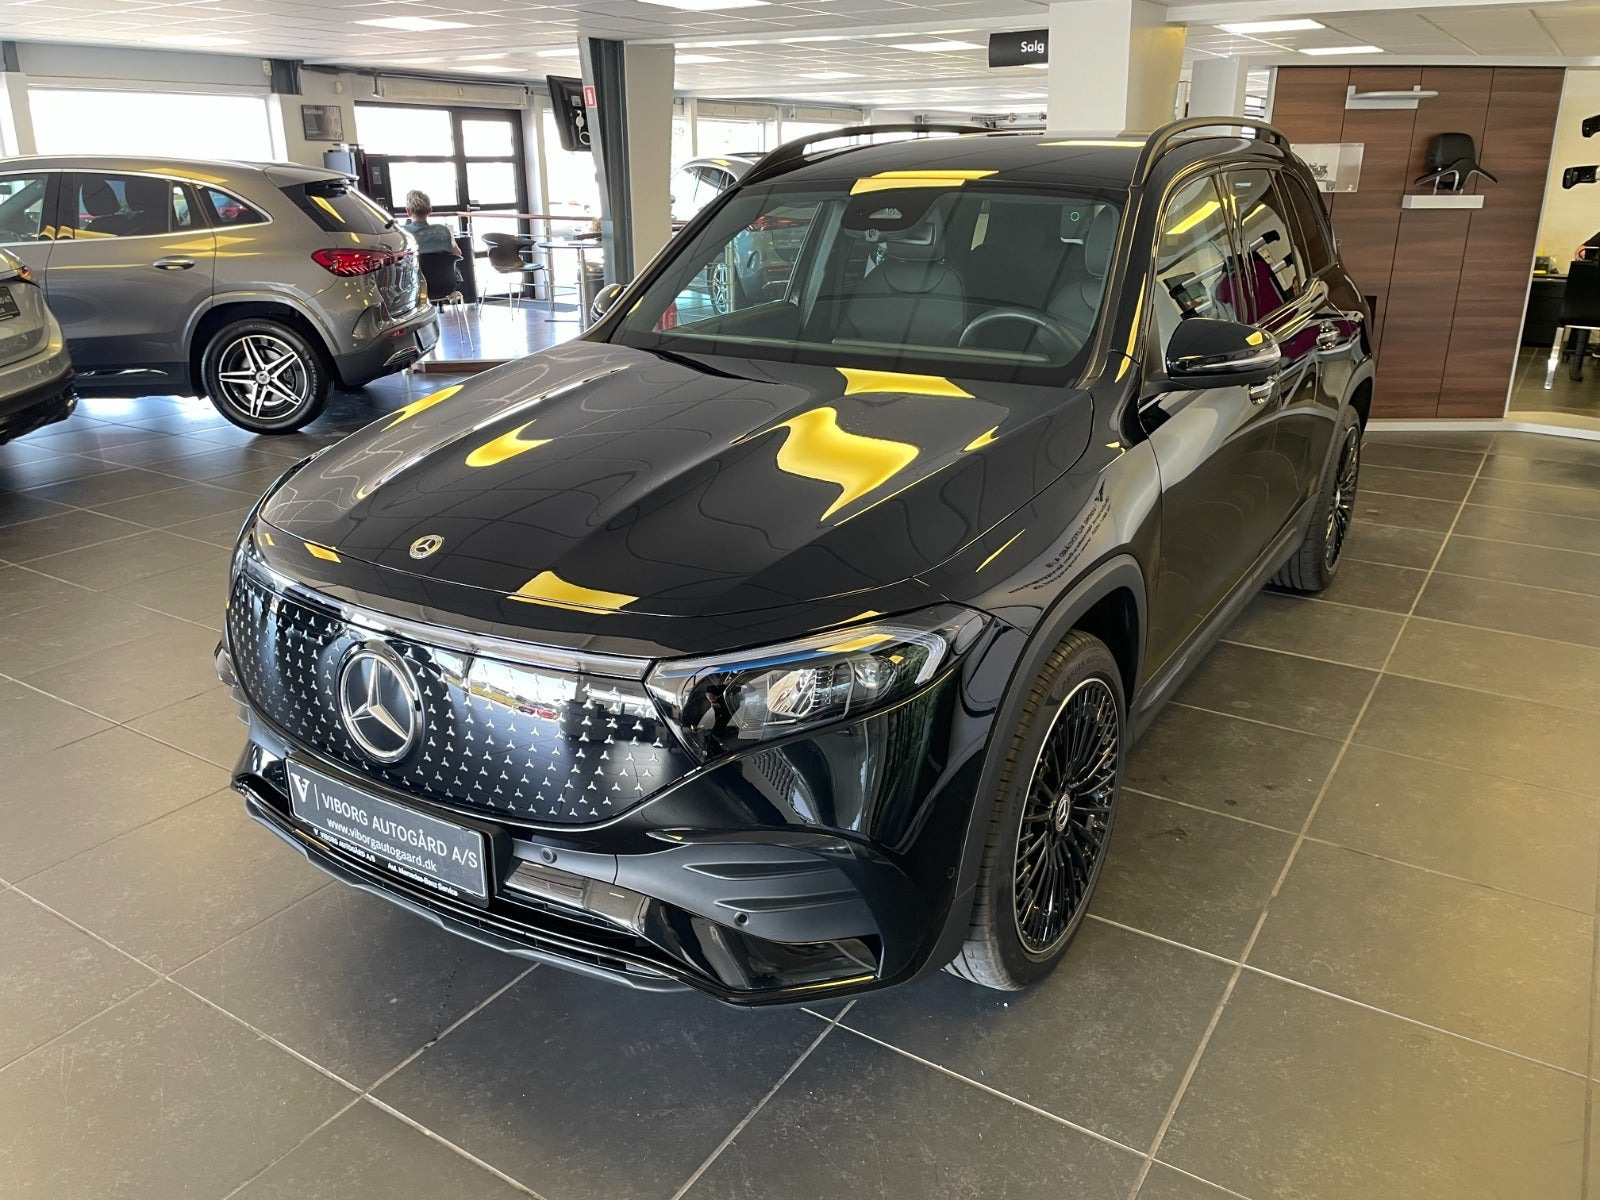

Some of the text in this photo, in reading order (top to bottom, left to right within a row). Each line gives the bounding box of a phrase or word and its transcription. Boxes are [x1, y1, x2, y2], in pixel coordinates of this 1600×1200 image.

[1020, 40, 1045, 54] Salg
[321, 792, 479, 869] VIBORG AUTOGÅRD A/S
[326, 818, 438, 872] www.viborgautogaard.dk
[437, 882, 459, 897] Service
